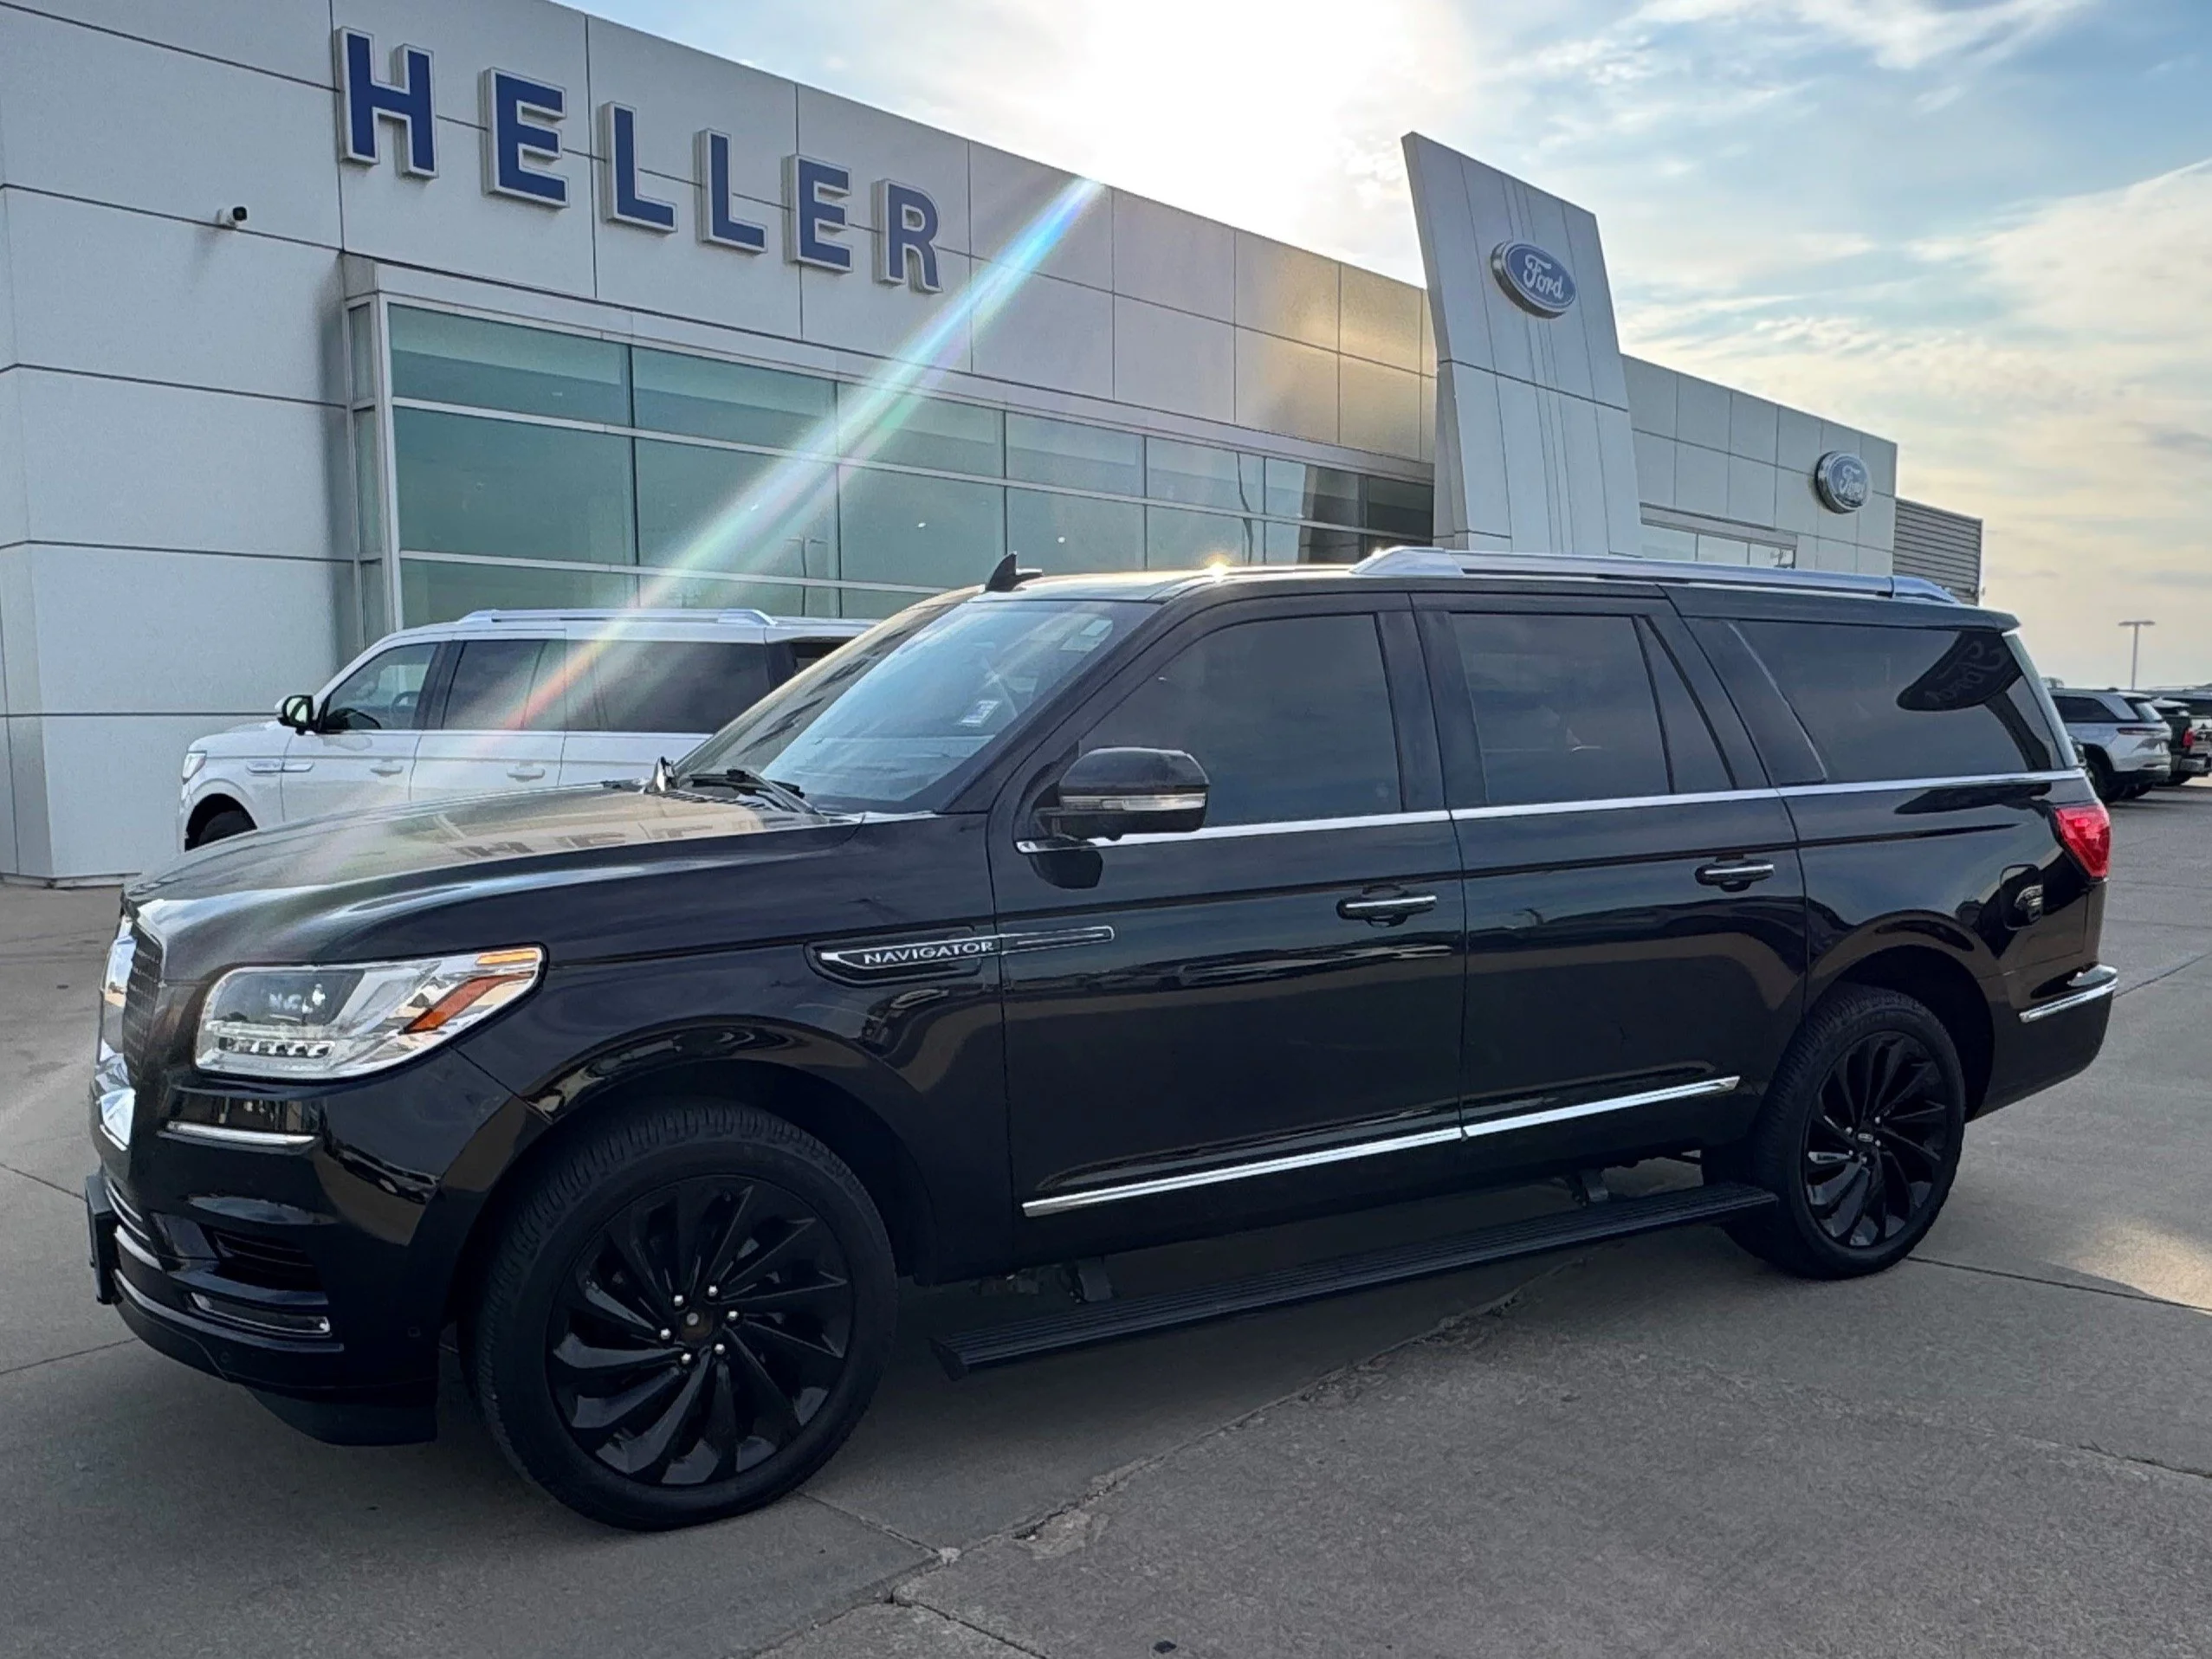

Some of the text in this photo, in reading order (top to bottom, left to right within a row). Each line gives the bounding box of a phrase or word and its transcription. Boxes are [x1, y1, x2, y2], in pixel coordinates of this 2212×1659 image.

[336, 26, 943, 294] HELLER
[1523, 254, 1564, 300] Ford
[863, 941, 994, 965] NAVIGATOR
